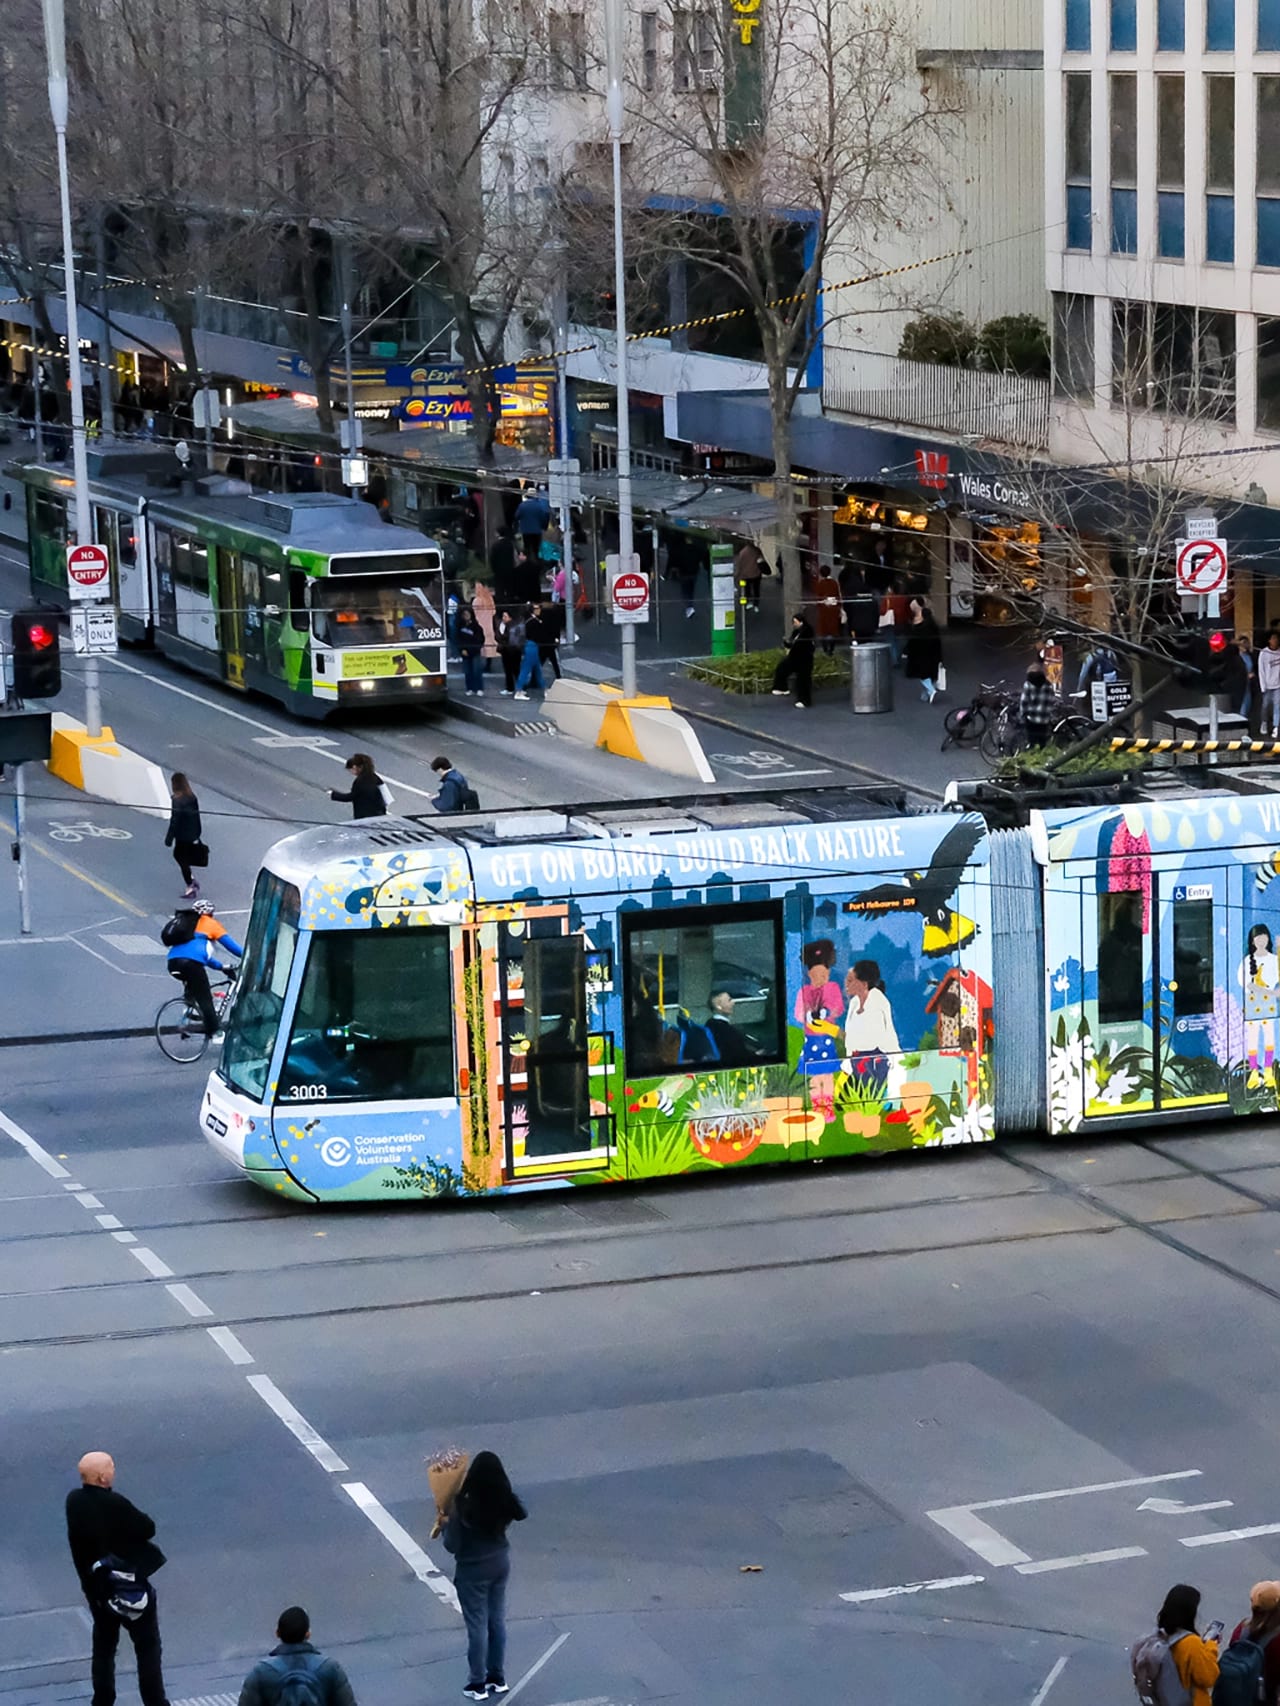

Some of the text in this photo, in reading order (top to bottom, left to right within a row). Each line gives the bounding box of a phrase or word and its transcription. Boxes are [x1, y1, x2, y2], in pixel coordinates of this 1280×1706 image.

[960, 475, 991, 499] Wales
[81, 551, 95, 560] NO
[75, 570, 103, 580] ENTRY
[624, 579, 637, 587] NO
[619, 597, 643, 606] ENTRY
[91, 630, 113, 640] ONLY
[417, 628, 442, 639] 2065
[491, 823, 905, 887] GET ON BOARD: BUILD BACK NATURE
[1188, 886, 1211, 898] Entry
[849, 902, 864, 910] Port
[866, 901, 900, 909] Melbourne
[290, 1085, 327, 1099] 3003
[354, 1133, 425, 1146] Conservation
[355, 1145, 412, 1155] Volunteers
[356, 1155, 400, 1165] Australia
